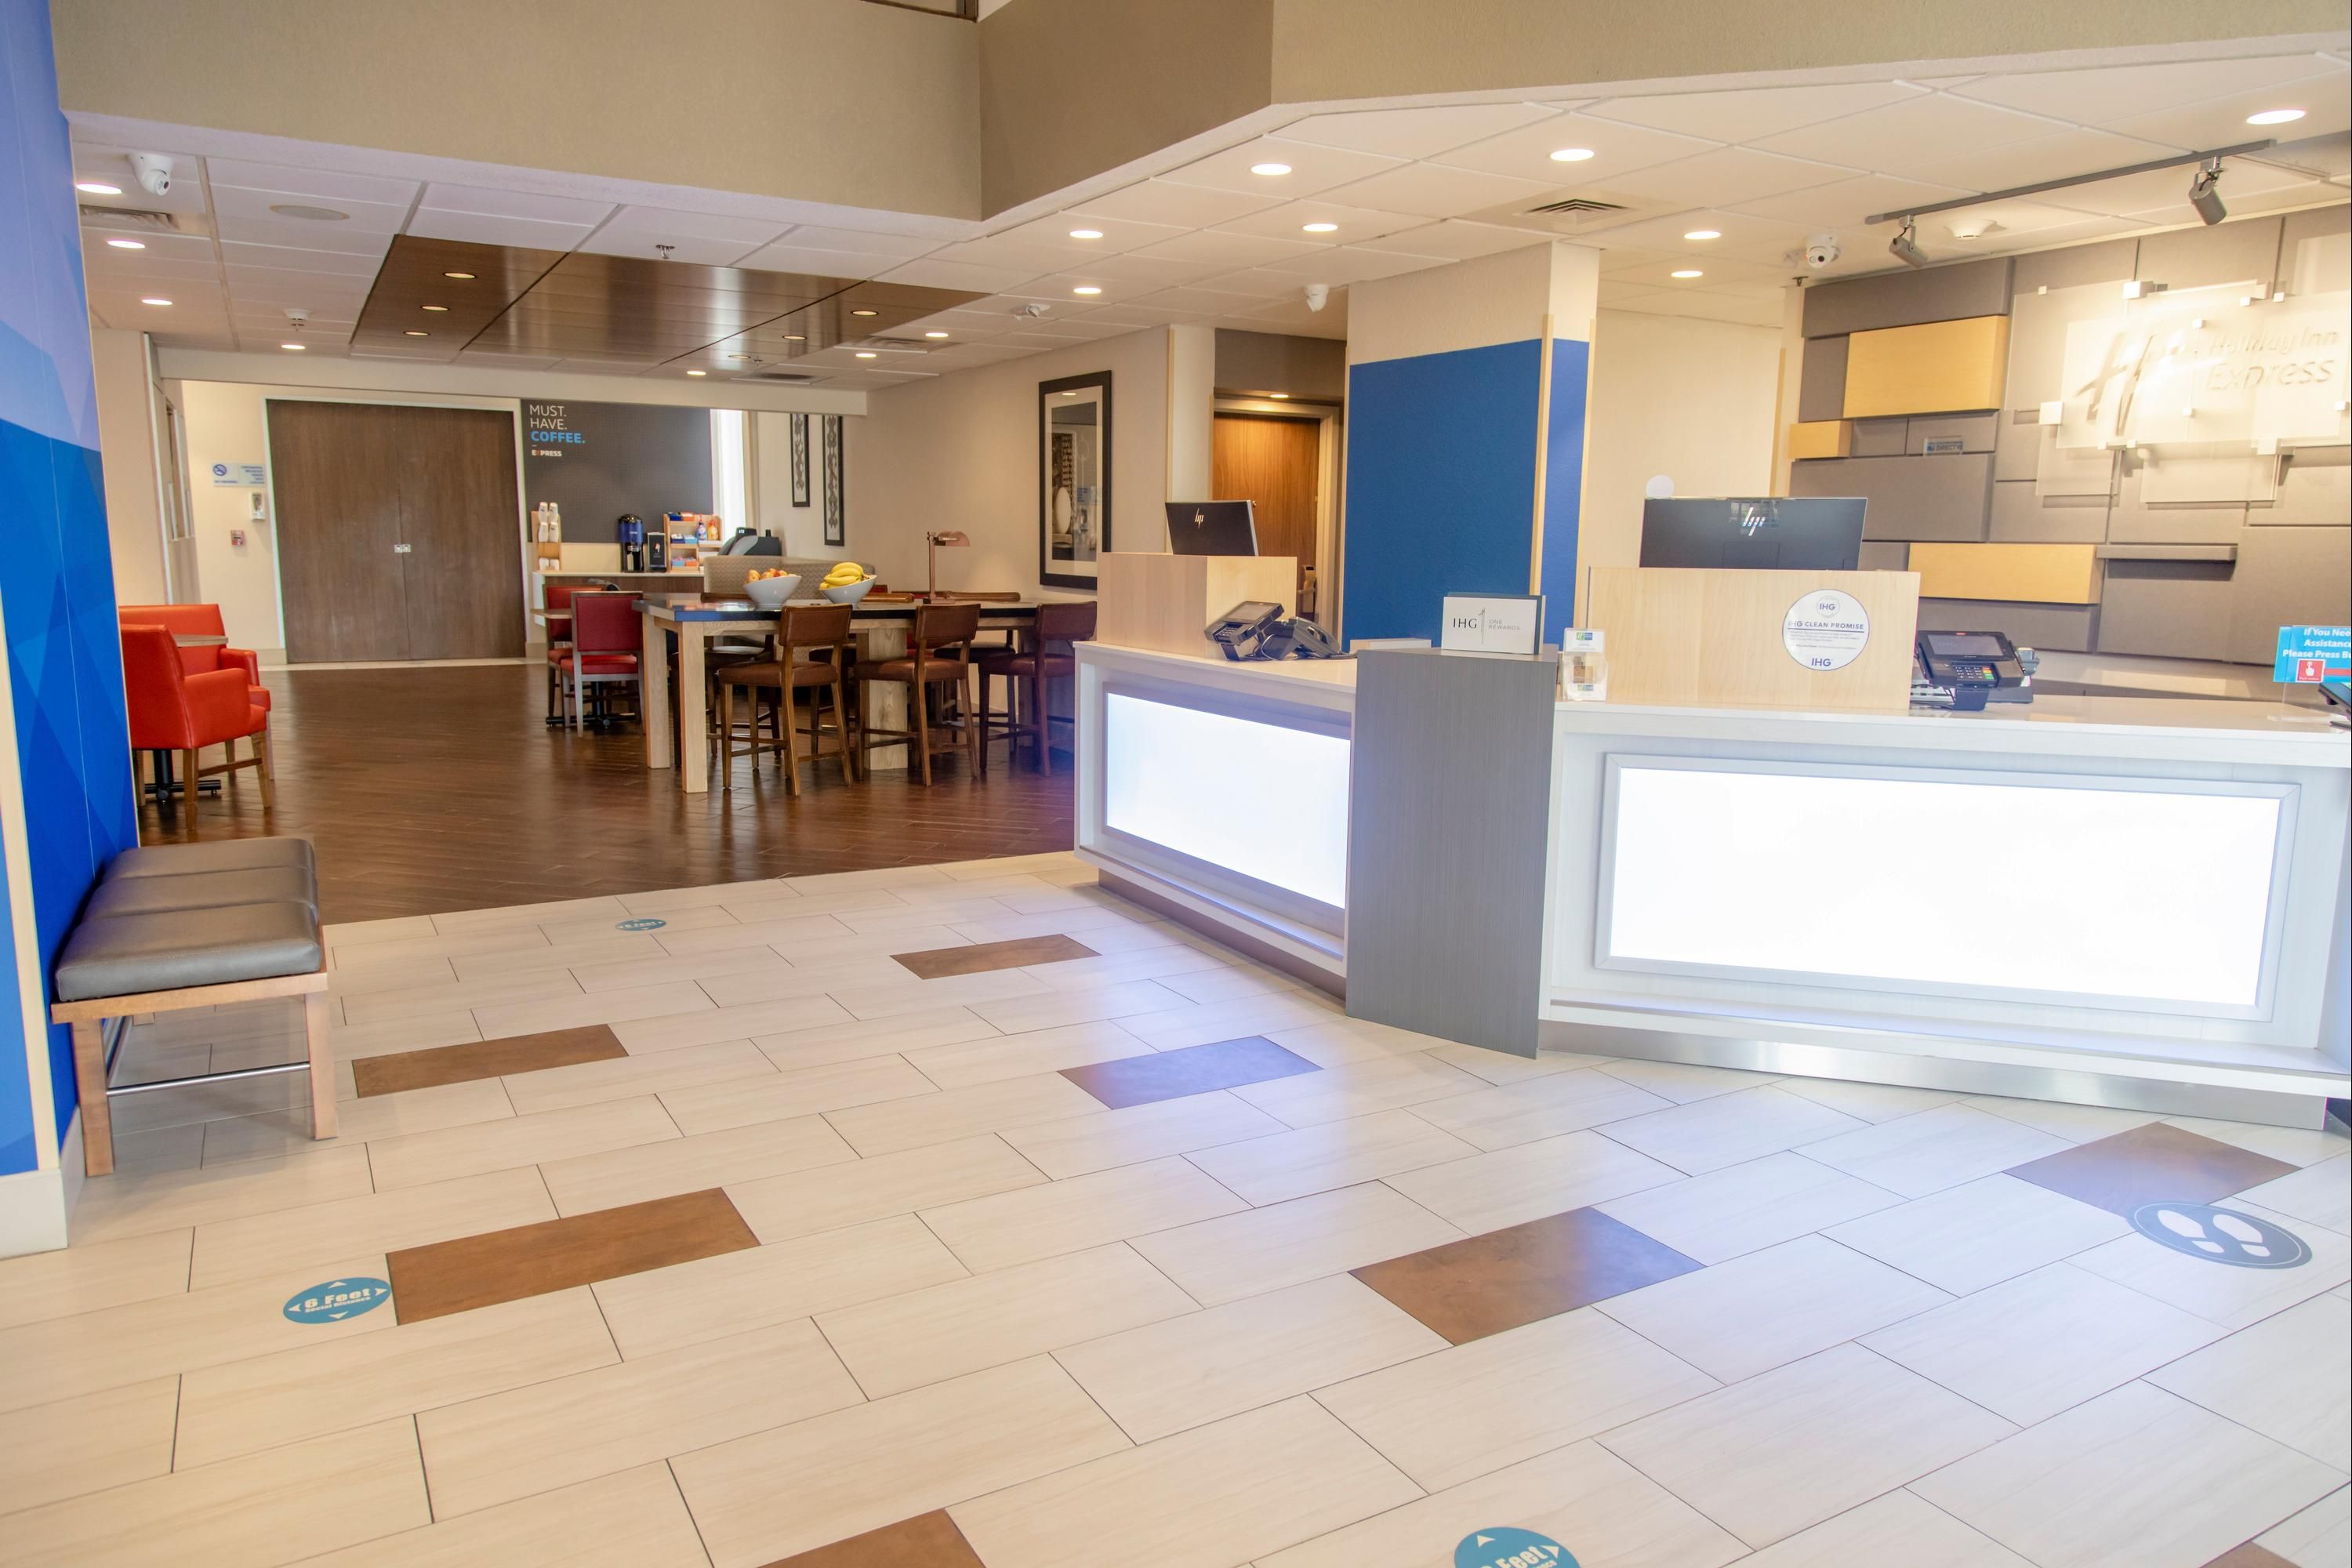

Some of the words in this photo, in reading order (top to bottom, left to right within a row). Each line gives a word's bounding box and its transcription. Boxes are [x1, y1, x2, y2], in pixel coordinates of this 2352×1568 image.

[2300, 326, 2340, 347] Inn
[2205, 359, 2335, 395] Express
[529, 405, 568, 417] MUST.
[530, 417, 568, 430] HAVE.
[531, 430, 586, 444] COFFEE.
[1453, 618, 1477, 629] IHG
[2303, 627, 2312, 636] If
[2313, 628, 2330, 637] You
[2282, 649, 2314, 658] Please
[2314, 650, 2340, 659] Press
[1811, 658, 1831, 667] IHG
[304, 1298, 318, 1308] 6
